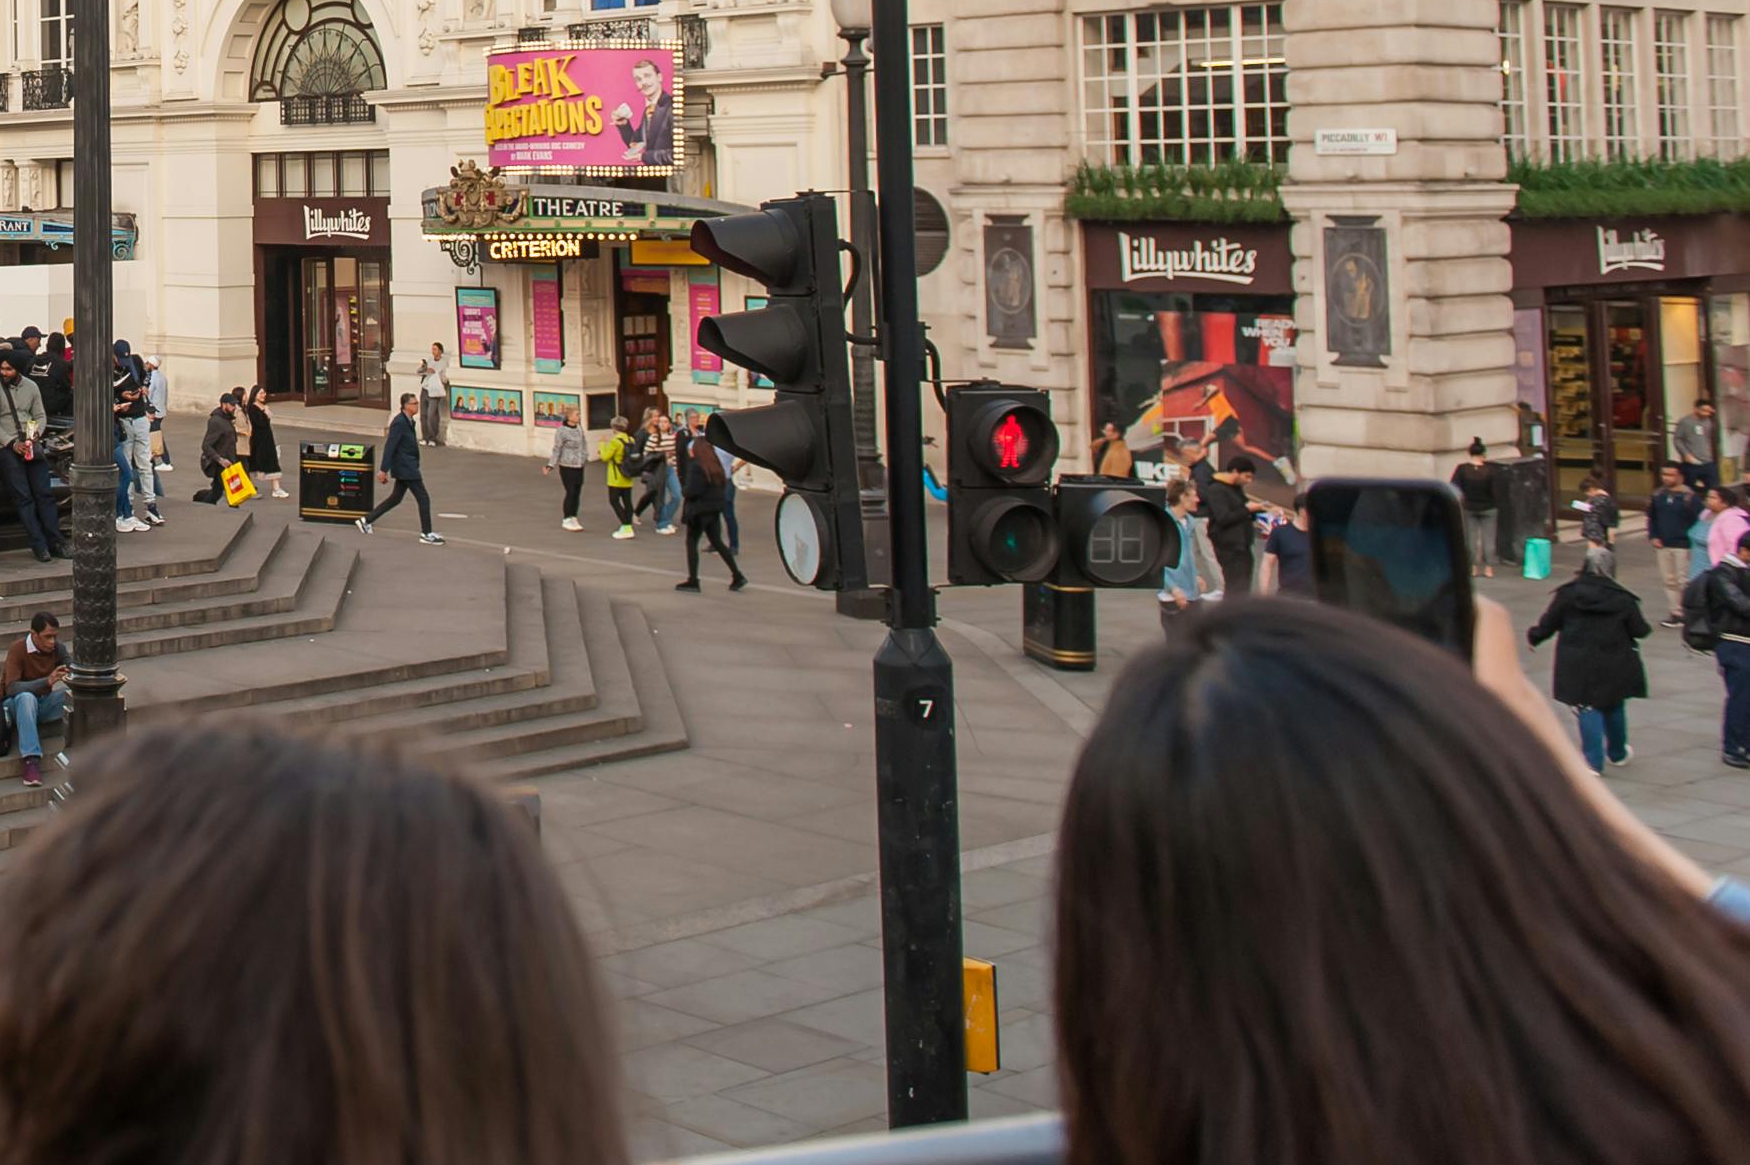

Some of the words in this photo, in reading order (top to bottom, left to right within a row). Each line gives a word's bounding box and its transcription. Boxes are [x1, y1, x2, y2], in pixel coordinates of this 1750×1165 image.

[489, 54, 584, 105] BLEAK
[562, 141, 585, 150] COMEDY
[1322, 132, 1369, 142] PICCADILLY
[532, 151, 553, 160] EVANS
[534, 197, 624, 217] THEATRE
[304, 205, 371, 240] Lillywhites
[489, 240, 581, 260] CRITERION
[1118, 232, 1257, 285] Lillywhites
[919, 700, 933, 718] 7
